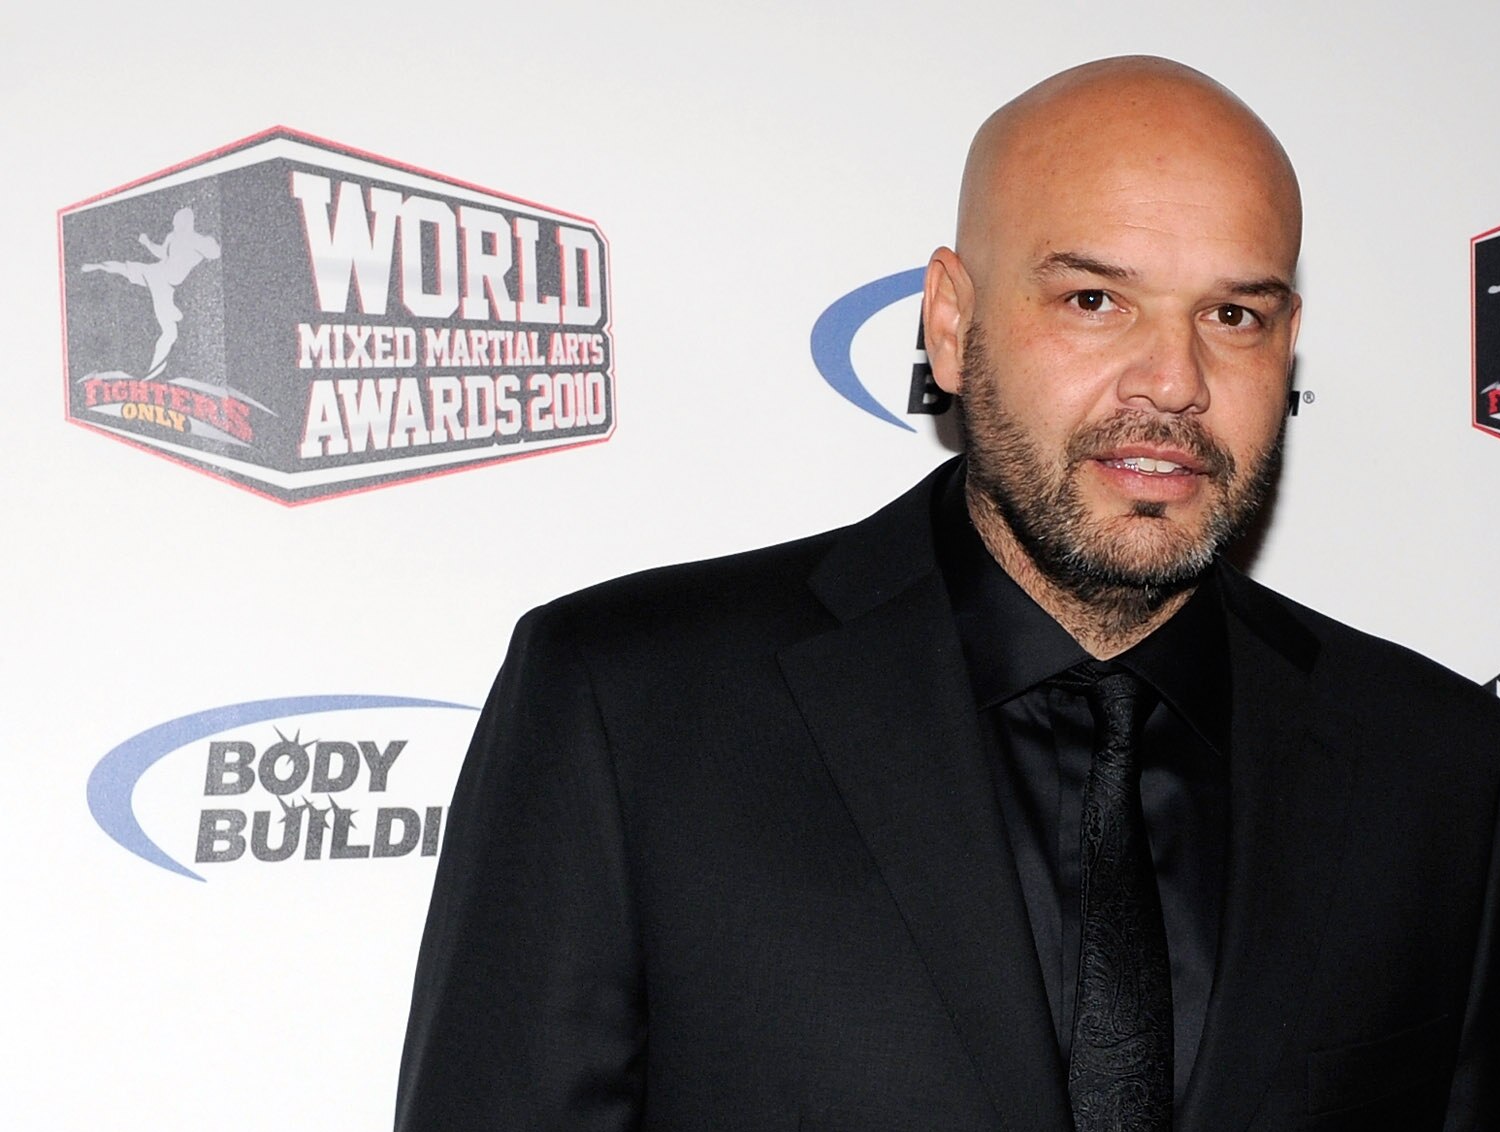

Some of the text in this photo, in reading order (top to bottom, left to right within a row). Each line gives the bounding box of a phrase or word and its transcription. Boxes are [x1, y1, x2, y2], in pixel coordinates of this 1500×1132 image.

[290, 171, 603, 326] WORLD
[298, 323, 605, 369] MIXED MARTIAL ARTS
[84, 378, 254, 442] FIGHTERS
[121, 402, 188, 433] ONLY
[300, 371, 607, 459] AWARDS 2010
[203, 738, 408, 797] BODY
[194, 803, 450, 864] BUILDI
